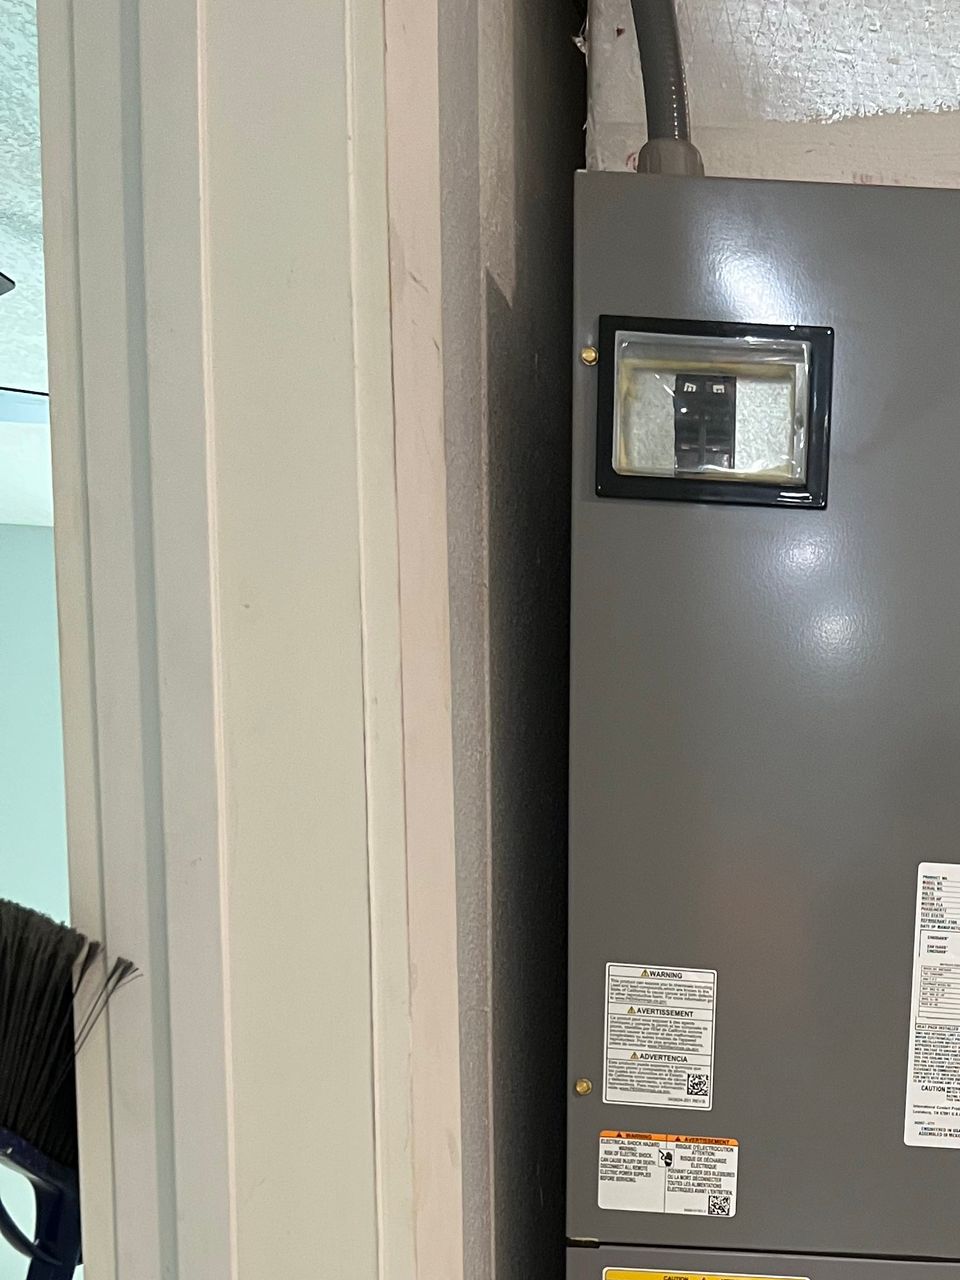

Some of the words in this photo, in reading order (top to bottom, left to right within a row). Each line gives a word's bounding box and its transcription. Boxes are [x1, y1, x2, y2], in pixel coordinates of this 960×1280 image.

[649, 971, 682, 979] WARNING
[637, 1008, 694, 1017] AVERTISSEMENT
[640, 1054, 688, 1062] ADVERTENCIA
